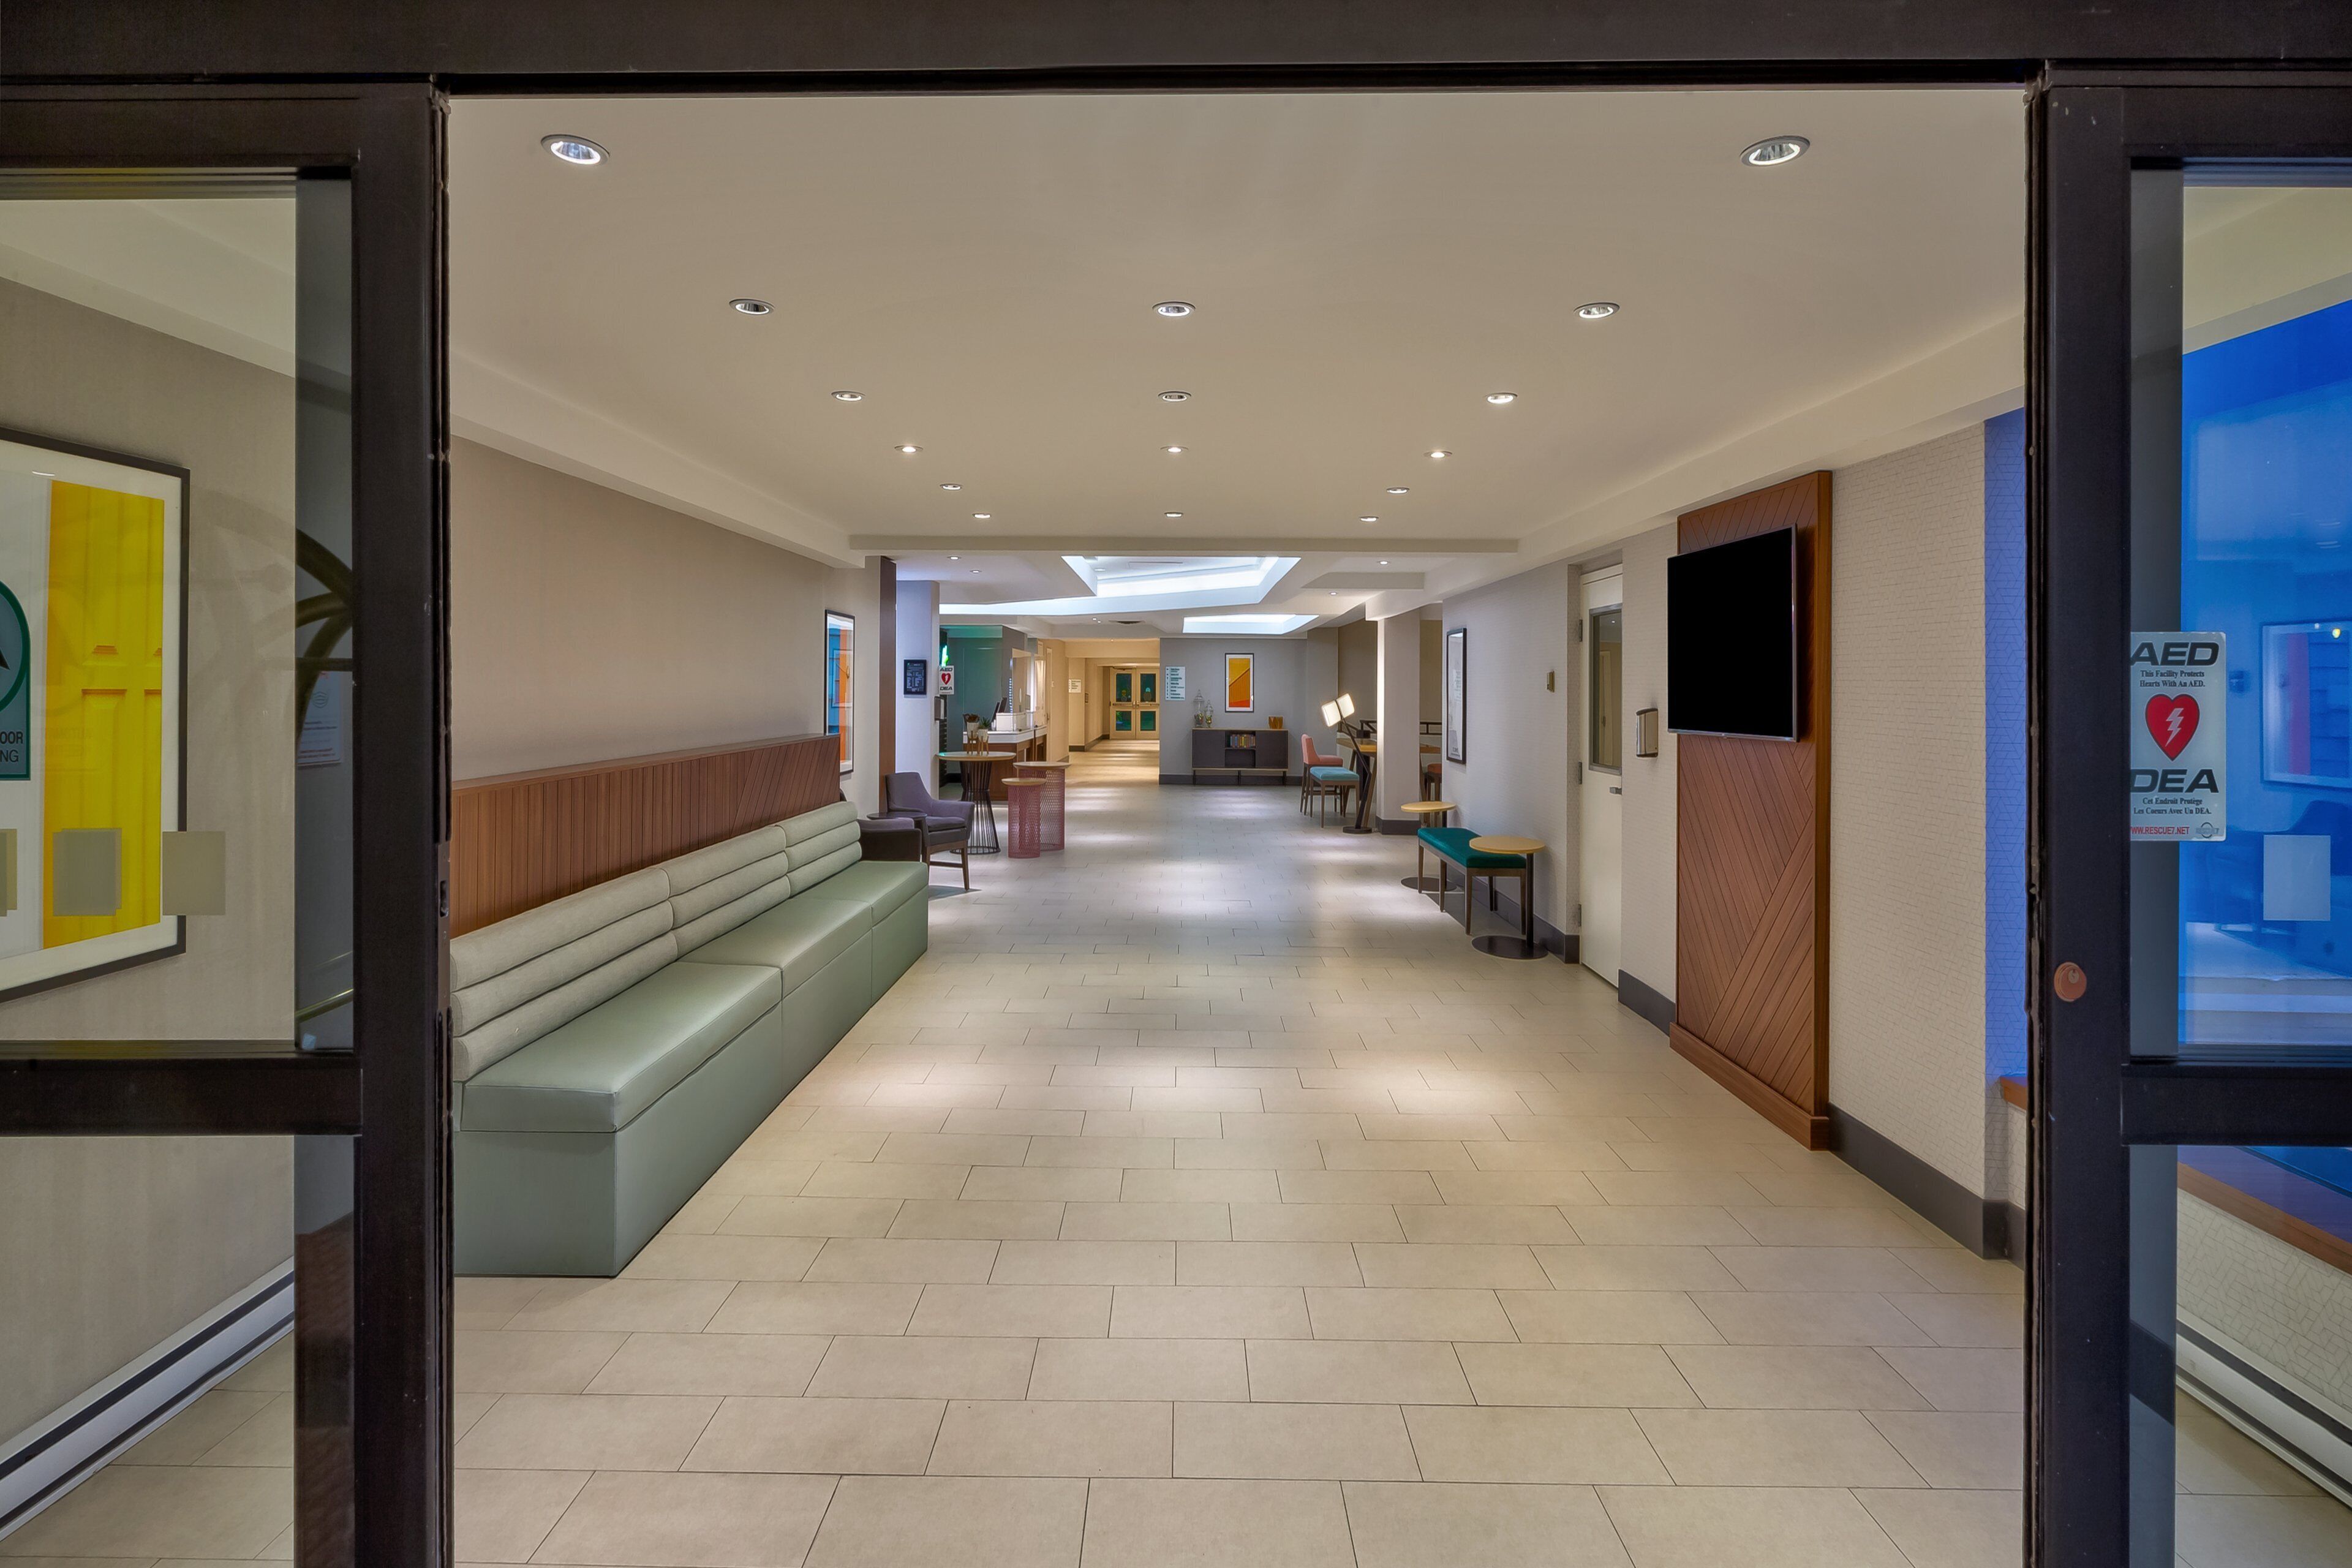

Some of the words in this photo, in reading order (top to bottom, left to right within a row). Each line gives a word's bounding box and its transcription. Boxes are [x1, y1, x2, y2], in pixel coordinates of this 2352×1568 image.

[2130, 642, 2219, 666] AED
[2155, 670, 2179, 679] Facility
[2130, 769, 2220, 793] DEA
